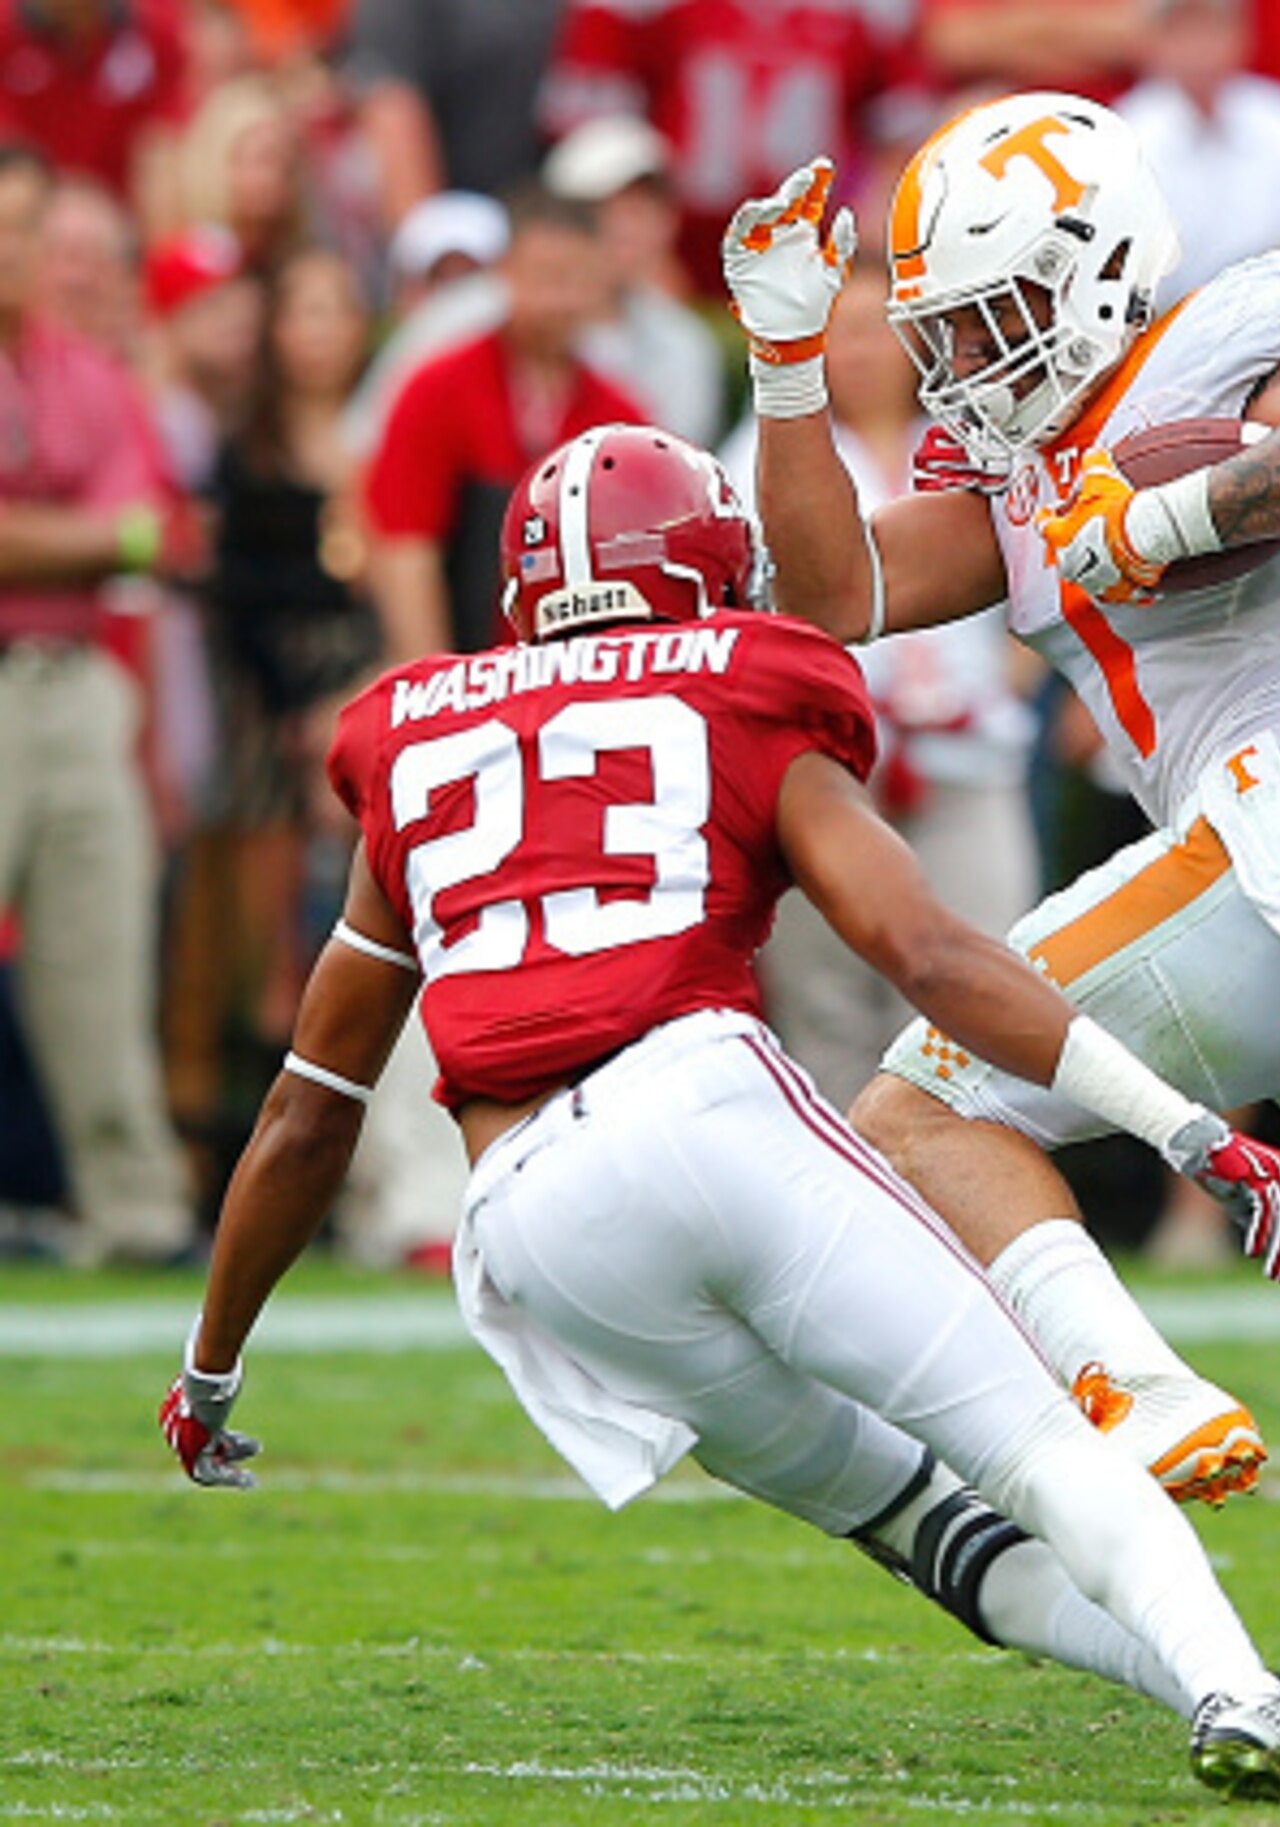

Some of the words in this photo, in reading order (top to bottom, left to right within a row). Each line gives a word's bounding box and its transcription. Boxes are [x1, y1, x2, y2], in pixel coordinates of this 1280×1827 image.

[978, 114, 1087, 213] T
[1055, 446, 1079, 485] T
[389, 627, 741, 730] WASHINGTON
[388, 692, 712, 980] 23
